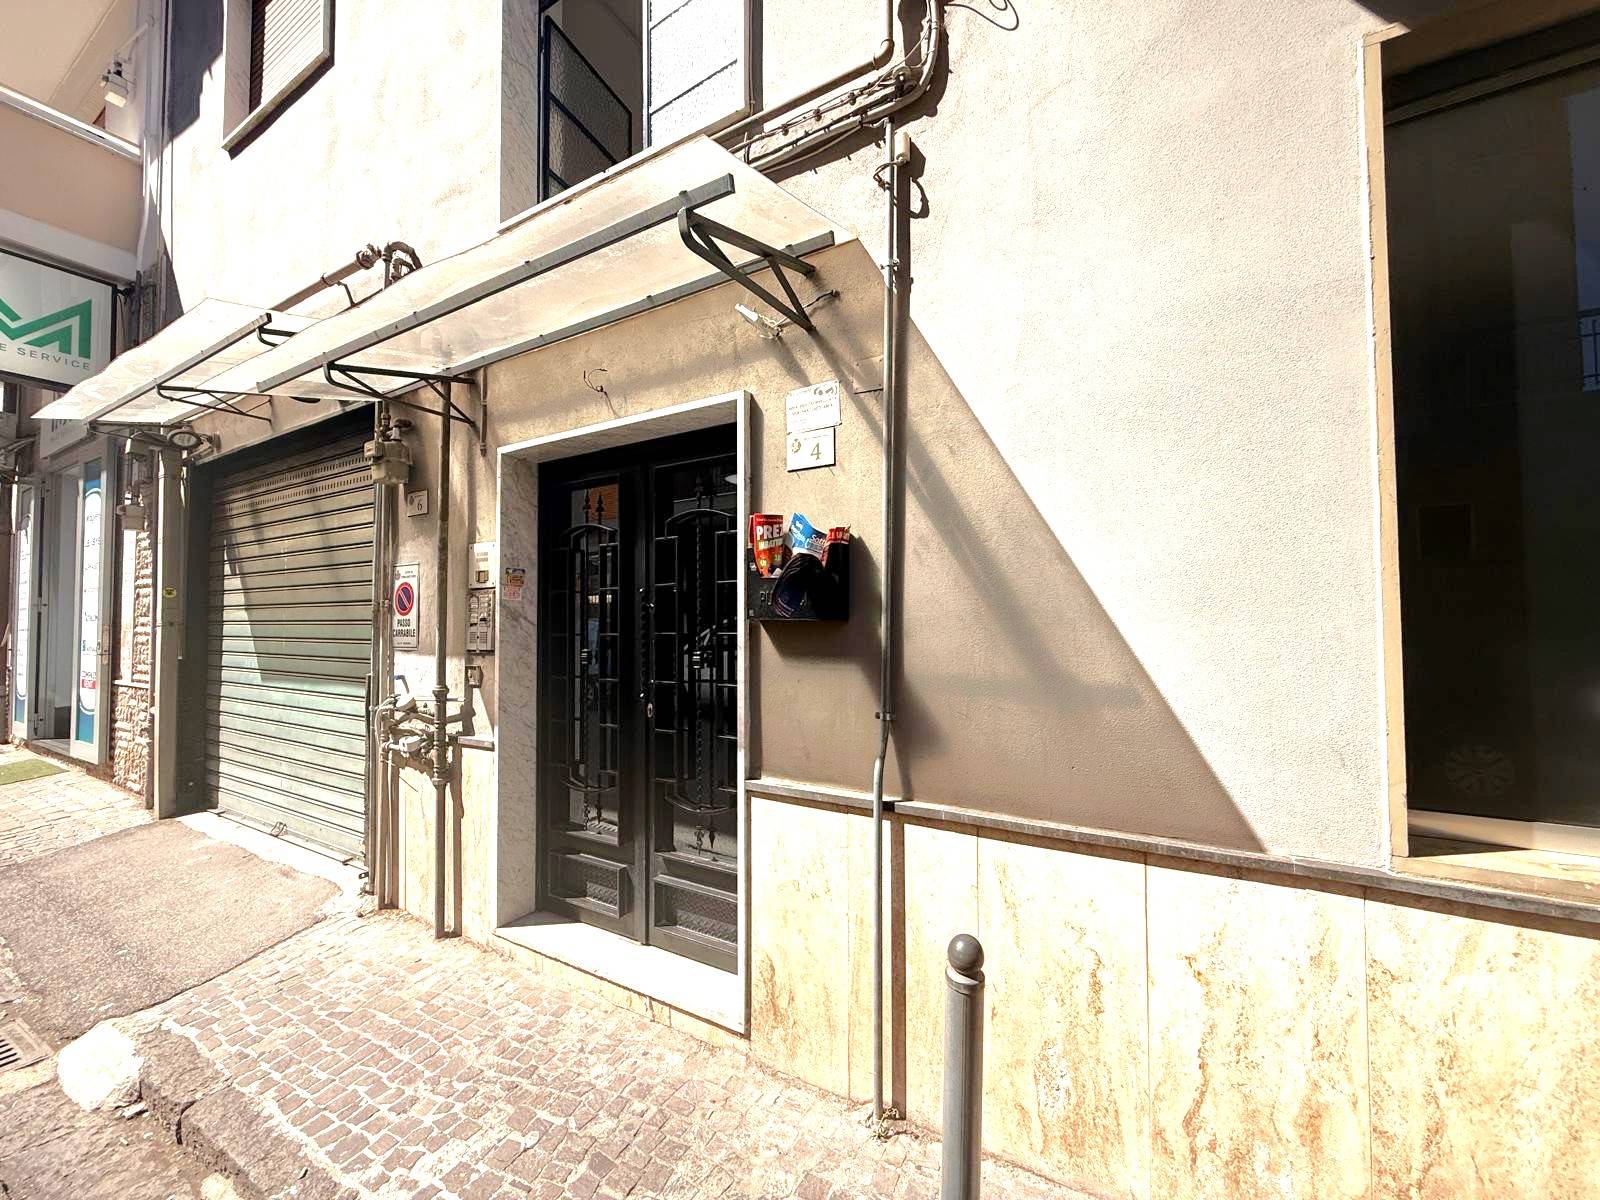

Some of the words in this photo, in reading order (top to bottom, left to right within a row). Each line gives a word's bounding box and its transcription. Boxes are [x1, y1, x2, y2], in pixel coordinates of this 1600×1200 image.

[17, 347, 90, 370] SERVICE
[810, 442, 822, 460] 4
[397, 618, 411, 627] PASSO
[392, 628, 416, 637] CARRABILE
